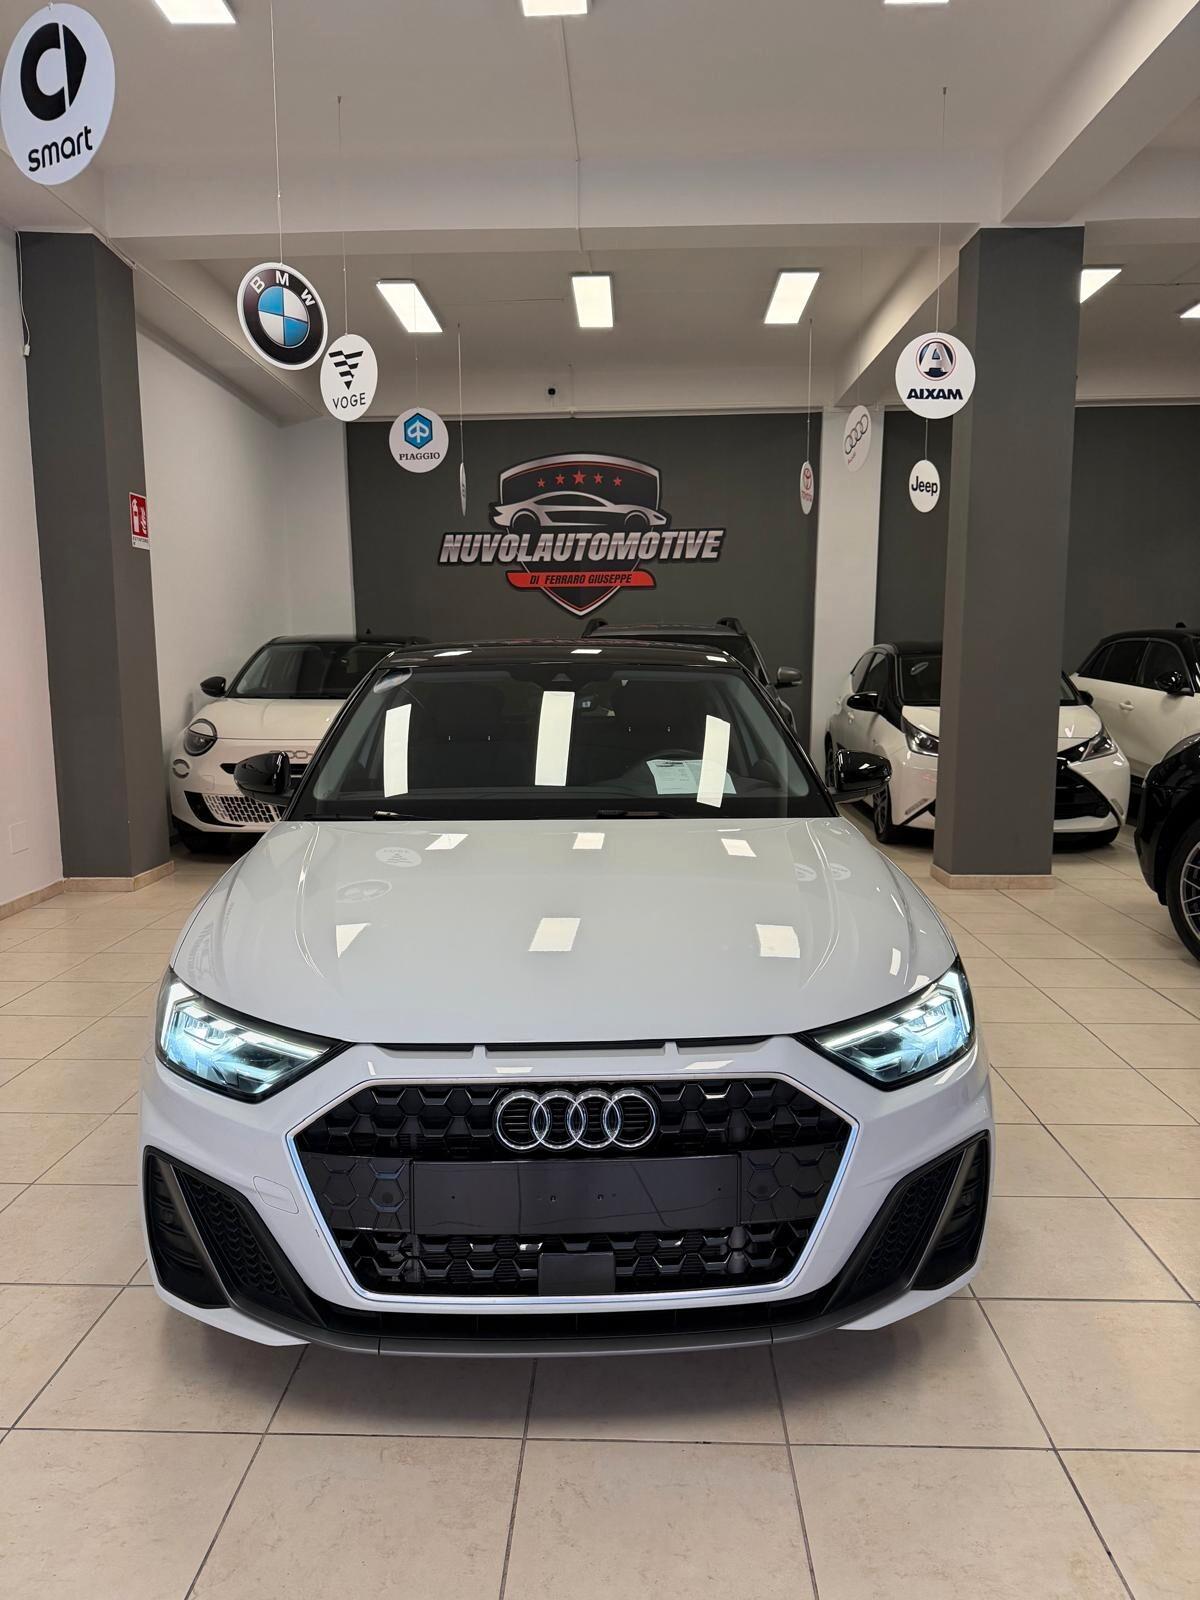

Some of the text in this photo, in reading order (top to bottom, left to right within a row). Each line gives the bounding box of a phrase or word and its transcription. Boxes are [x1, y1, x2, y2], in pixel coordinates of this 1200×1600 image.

[28, 125, 93, 172] smart
[250, 270, 316, 306] BMW
[332, 392, 367, 410] VOGE
[906, 388, 963, 400] AIXAM
[399, 451, 440, 461] PIAGGIO
[911, 475, 938, 496] Jeep
[439, 529, 724, 563] NUVOLAUTOMOTIVE
[530, 573, 632, 585] DI FERRARO GIUSEPPE
